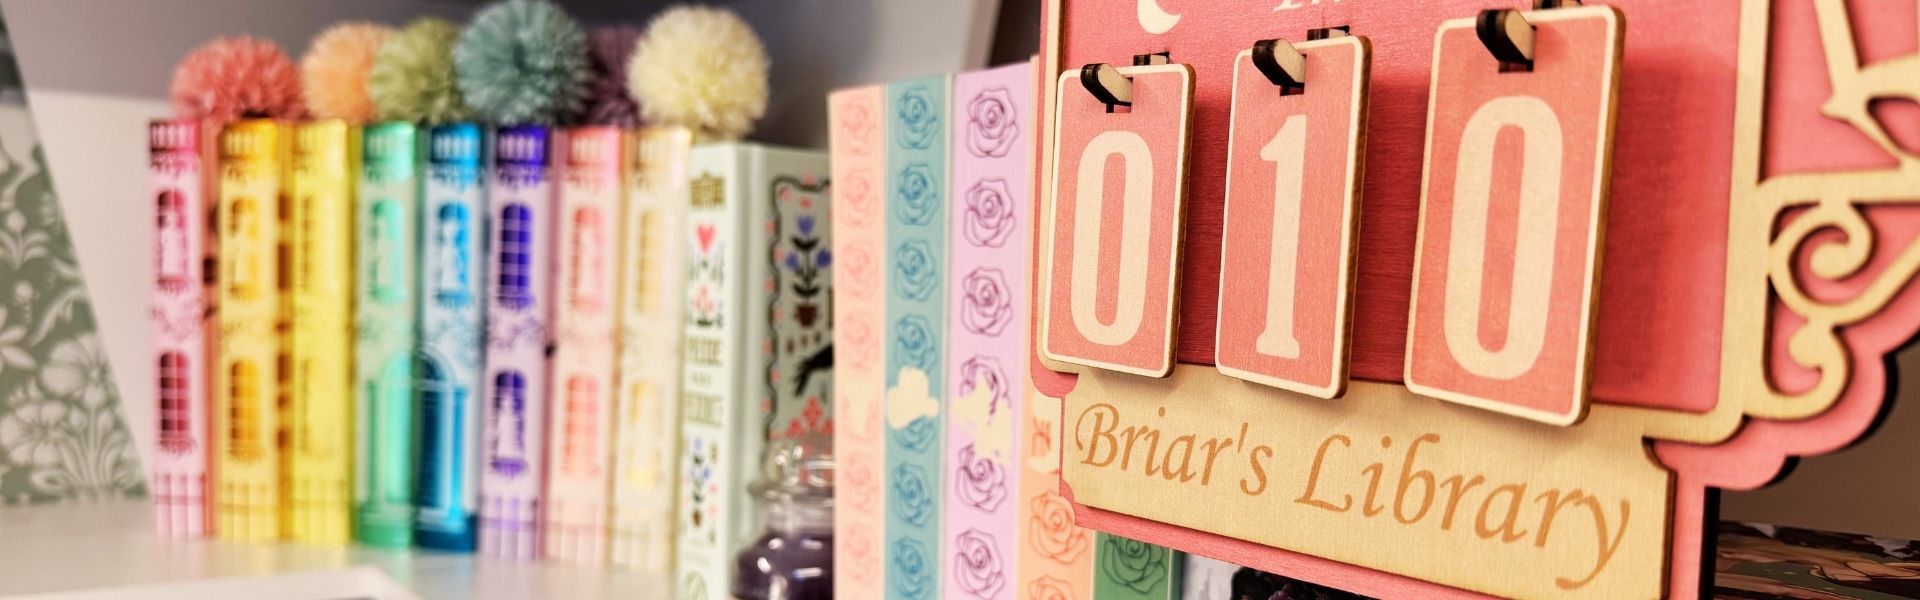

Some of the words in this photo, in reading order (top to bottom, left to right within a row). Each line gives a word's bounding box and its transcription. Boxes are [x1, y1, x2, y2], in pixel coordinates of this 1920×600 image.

[1070, 131, 1153, 346] 0
[1256, 114, 1308, 359] 1
[1444, 96, 1562, 380] 0
[1075, 403, 1273, 496] Briar's
[1295, 433, 1630, 590] Library
